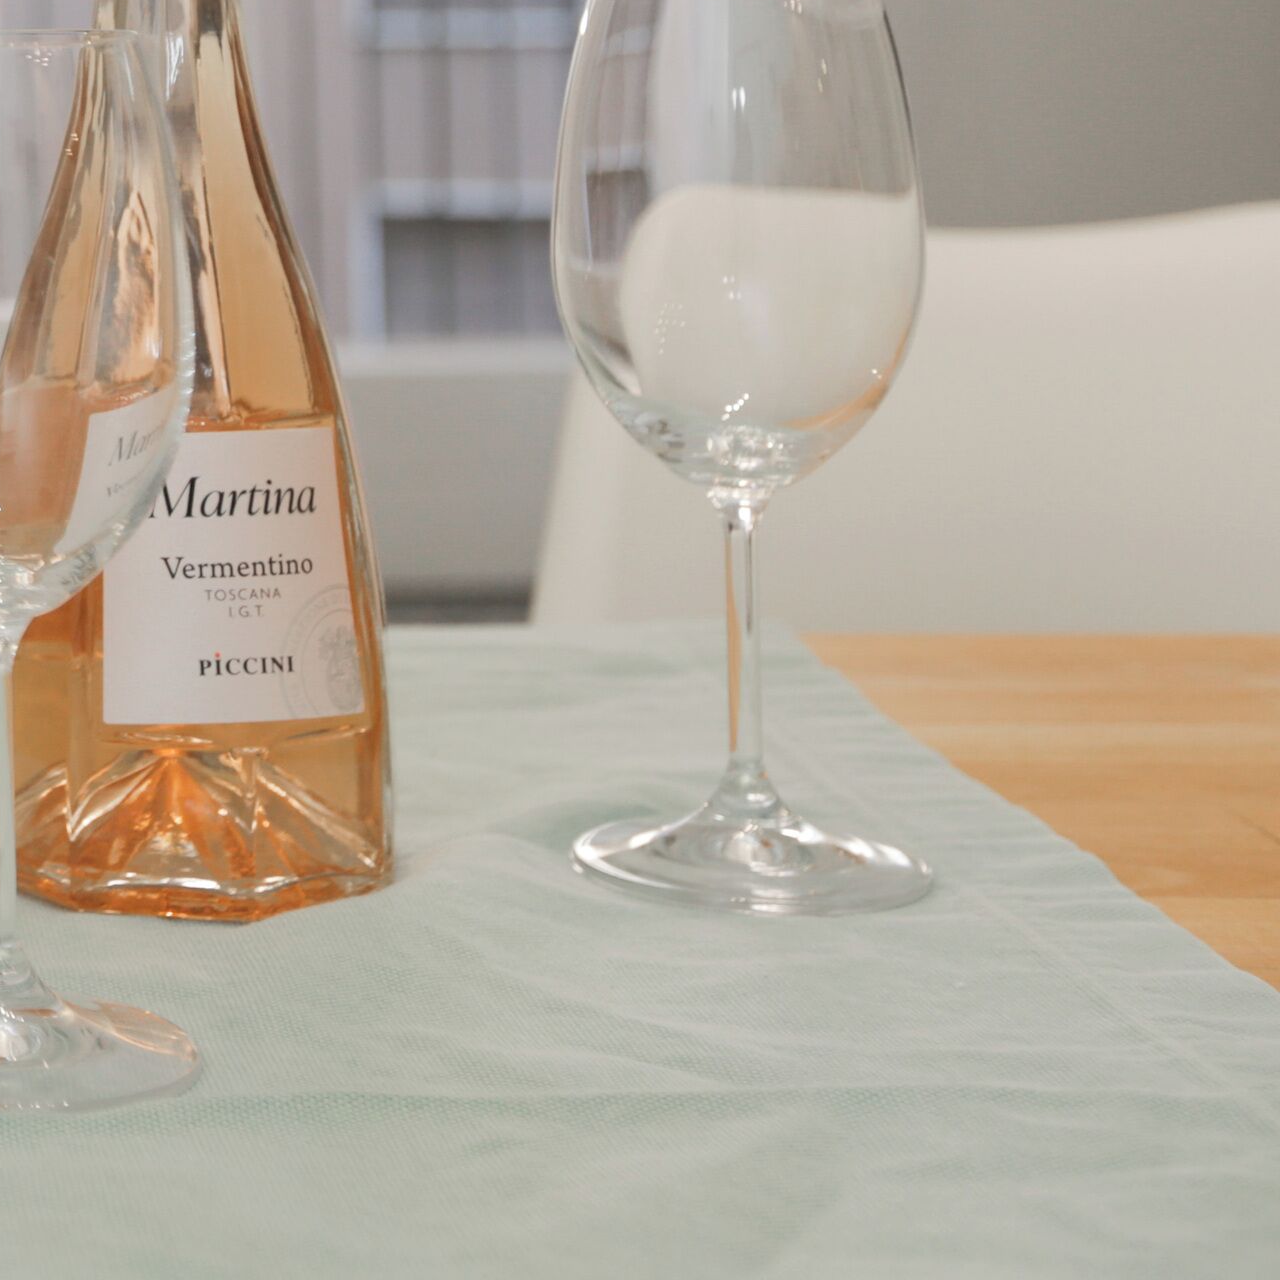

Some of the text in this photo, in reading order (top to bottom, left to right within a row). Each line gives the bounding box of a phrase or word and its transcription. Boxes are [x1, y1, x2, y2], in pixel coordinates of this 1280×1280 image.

[148, 476, 317, 519] Martina
[161, 554, 314, 580] Vermentino
[204, 587, 282, 602] TOSCANA
